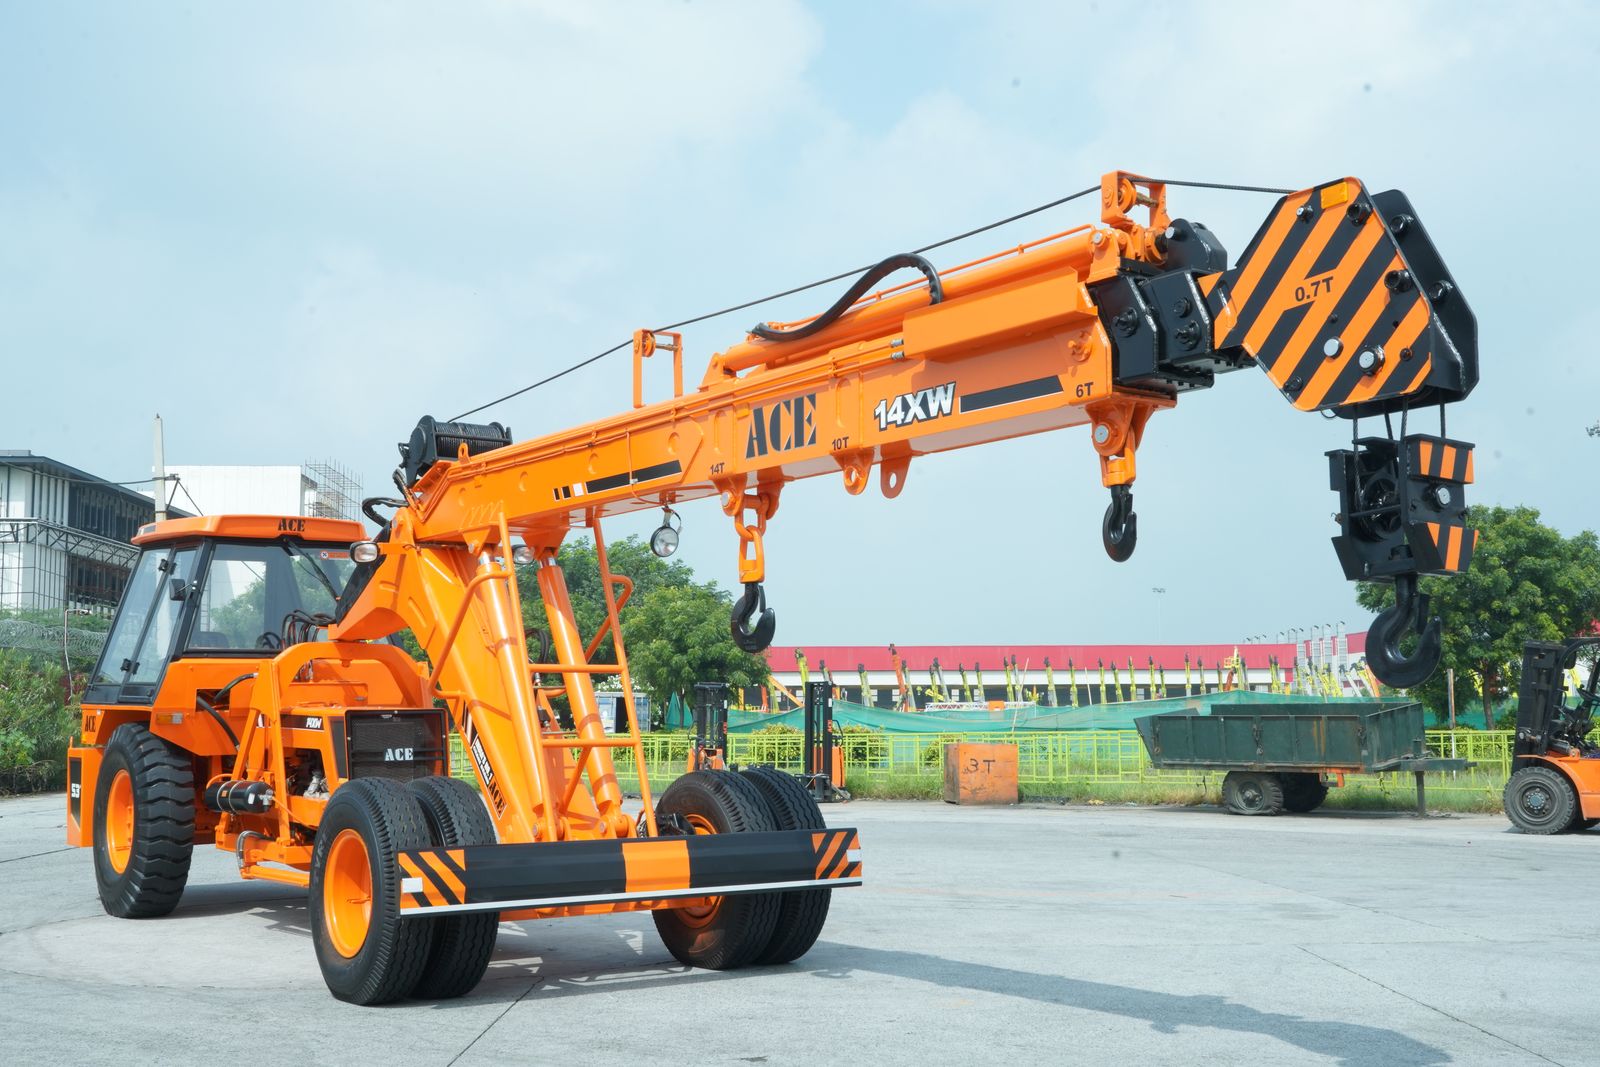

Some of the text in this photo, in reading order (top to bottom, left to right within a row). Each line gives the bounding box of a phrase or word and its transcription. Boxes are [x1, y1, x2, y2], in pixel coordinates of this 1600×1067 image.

[1295, 276, 1333, 302] 0.7T
[1076, 382, 1094, 398] 6T
[873, 381, 957, 432] 14XW
[745, 393, 817, 459] ACE
[832, 437, 849, 451] 10T
[710, 463, 725, 475] 14T
[278, 518, 305, 532] ACE
[84, 715, 96, 732] ACE
[384, 748, 414, 761] ACE
[489, 782, 506, 815] ACE
